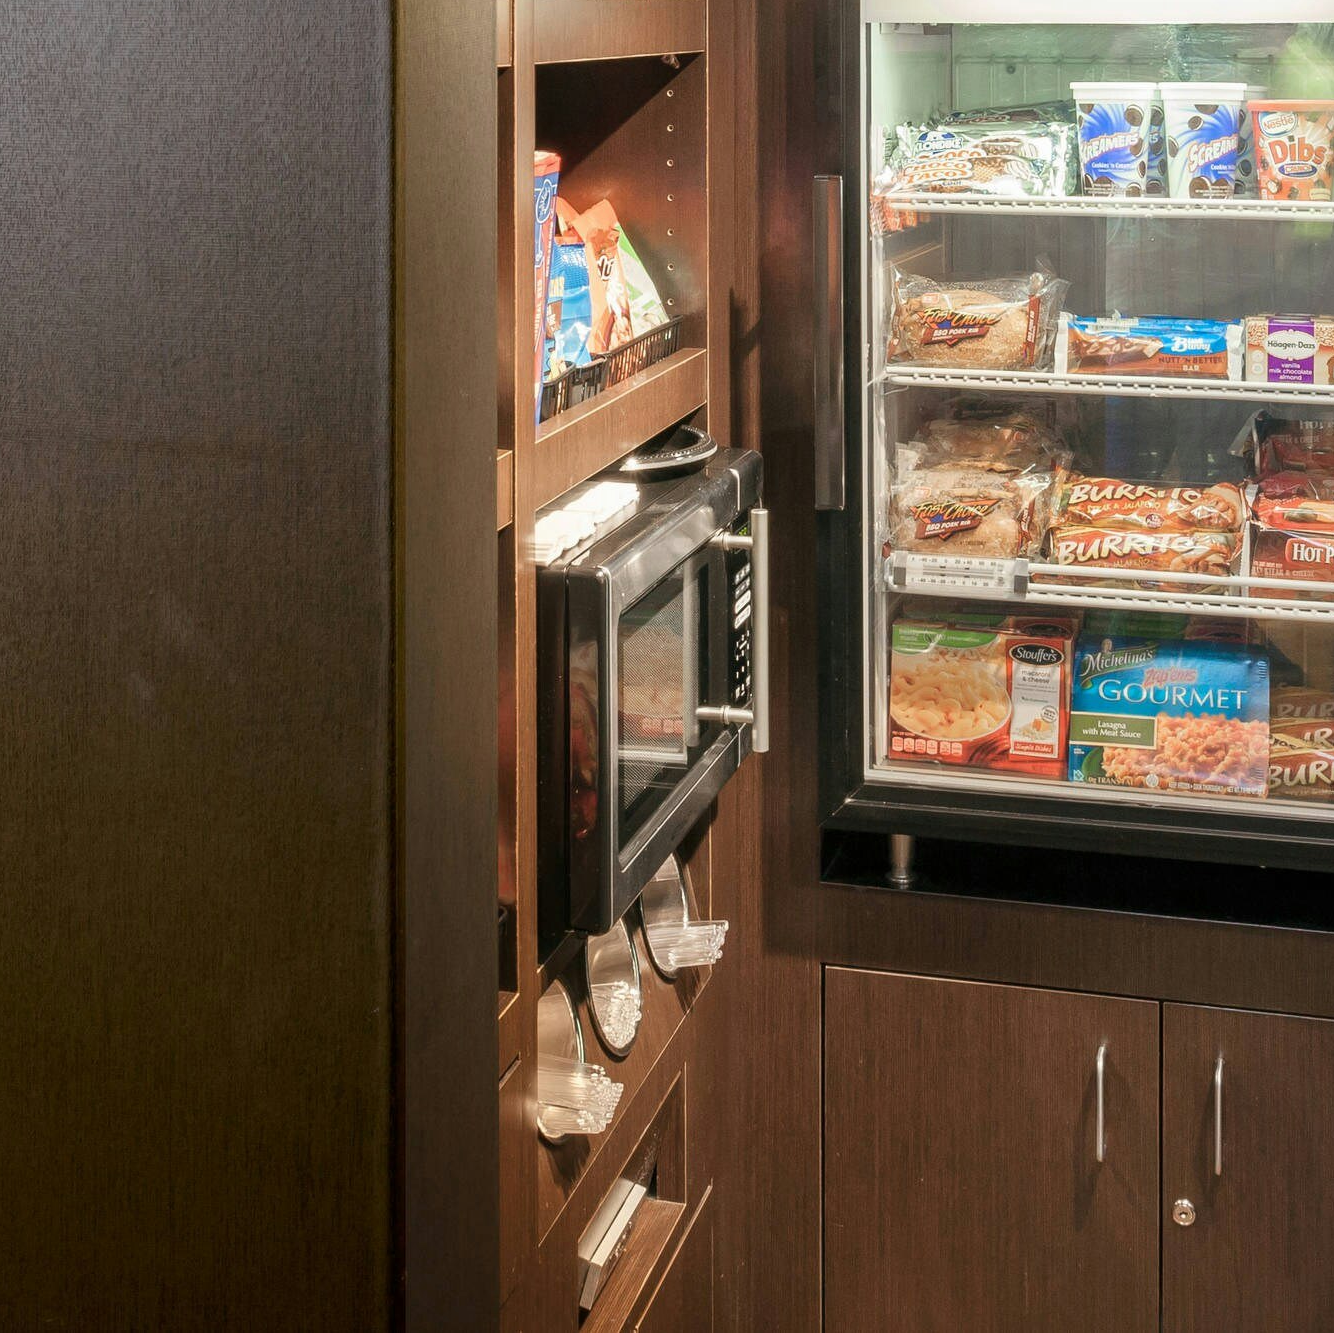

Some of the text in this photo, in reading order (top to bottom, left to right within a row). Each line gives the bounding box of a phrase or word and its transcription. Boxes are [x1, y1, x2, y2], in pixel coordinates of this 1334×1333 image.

[1264, 116, 1294, 129] Nestlé
[1268, 136, 1328, 165] Dibs
[922, 307, 1001, 327] Fast Choice
[934, 328, 948, 337] BBQ
[949, 327, 967, 336] PORK
[1192, 357, 1223, 365] BETTER
[1281, 362, 1301, 370] vanilla
[1183, 364, 1200, 372] BAR
[1269, 367, 1282, 375] milk
[915, 501, 990, 520] Fast Choice
[925, 523, 940, 532] BBQ
[940, 521, 960, 530] PORK
[1057, 533, 1197, 565] BURRITO
[1292, 542, 1323, 563] HOT
[1015, 647, 1058, 663] Stouffer's
[1079, 647, 1156, 677] Michelina's
[1098, 678, 1248, 711] GOURMET
[1097, 720, 1127, 730] Lasagna
[1082, 728, 1142, 739] with Meat Sauce
